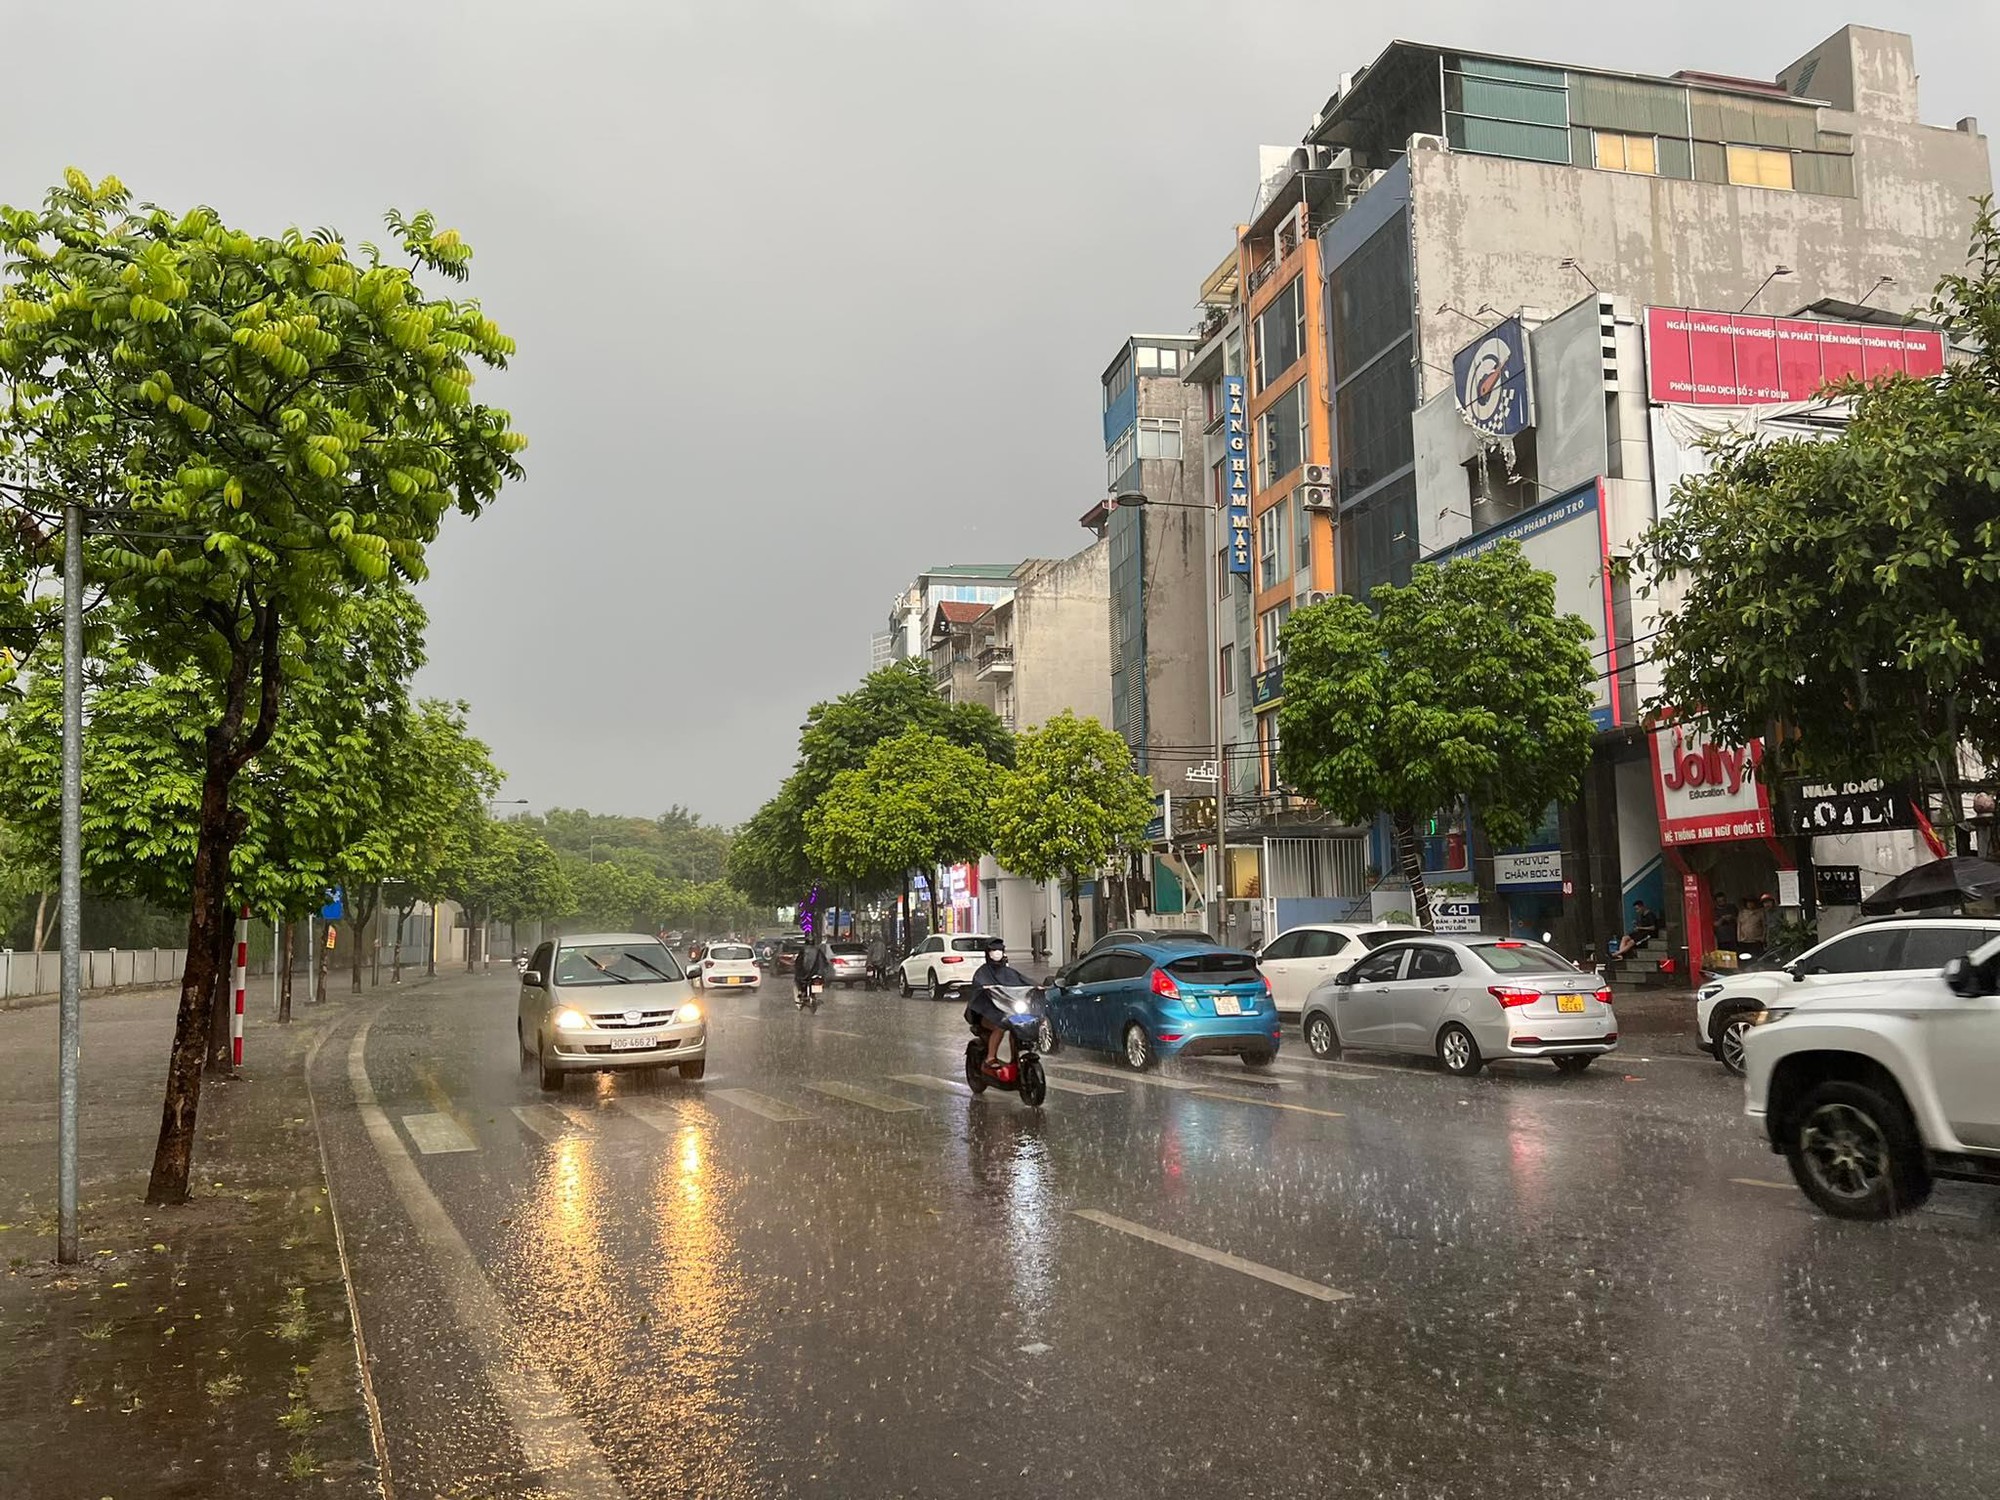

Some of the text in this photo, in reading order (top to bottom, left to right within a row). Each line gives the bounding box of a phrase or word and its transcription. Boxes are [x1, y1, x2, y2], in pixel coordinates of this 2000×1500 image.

[1693, 321, 1720, 333] HÀNG
[1778, 329, 1790, 340] VÀ
[1791, 330, 1815, 341] PHÁT
[1906, 341, 1927, 352] NAM
[1669, 380, 1696, 393] PHÒNG
[1697, 384, 1717, 394] GIAO
[1717, 385, 1737, 397] DỊCH
[1737, 383, 1748, 396] SỐ
[1748, 388, 1754, 396] 2
[1228, 383, 1249, 564] RĂNG HÀM MẶT
[1664, 742, 1745, 795] Jolly
[1688, 787, 1726, 800] Education
[1664, 830, 1674, 843] HỆ
[1697, 827, 1713, 839] ANH
[1549, 868, 1561, 878] XE
[1562, 882, 1573, 894] 40
[1447, 904, 1470, 916] 40
